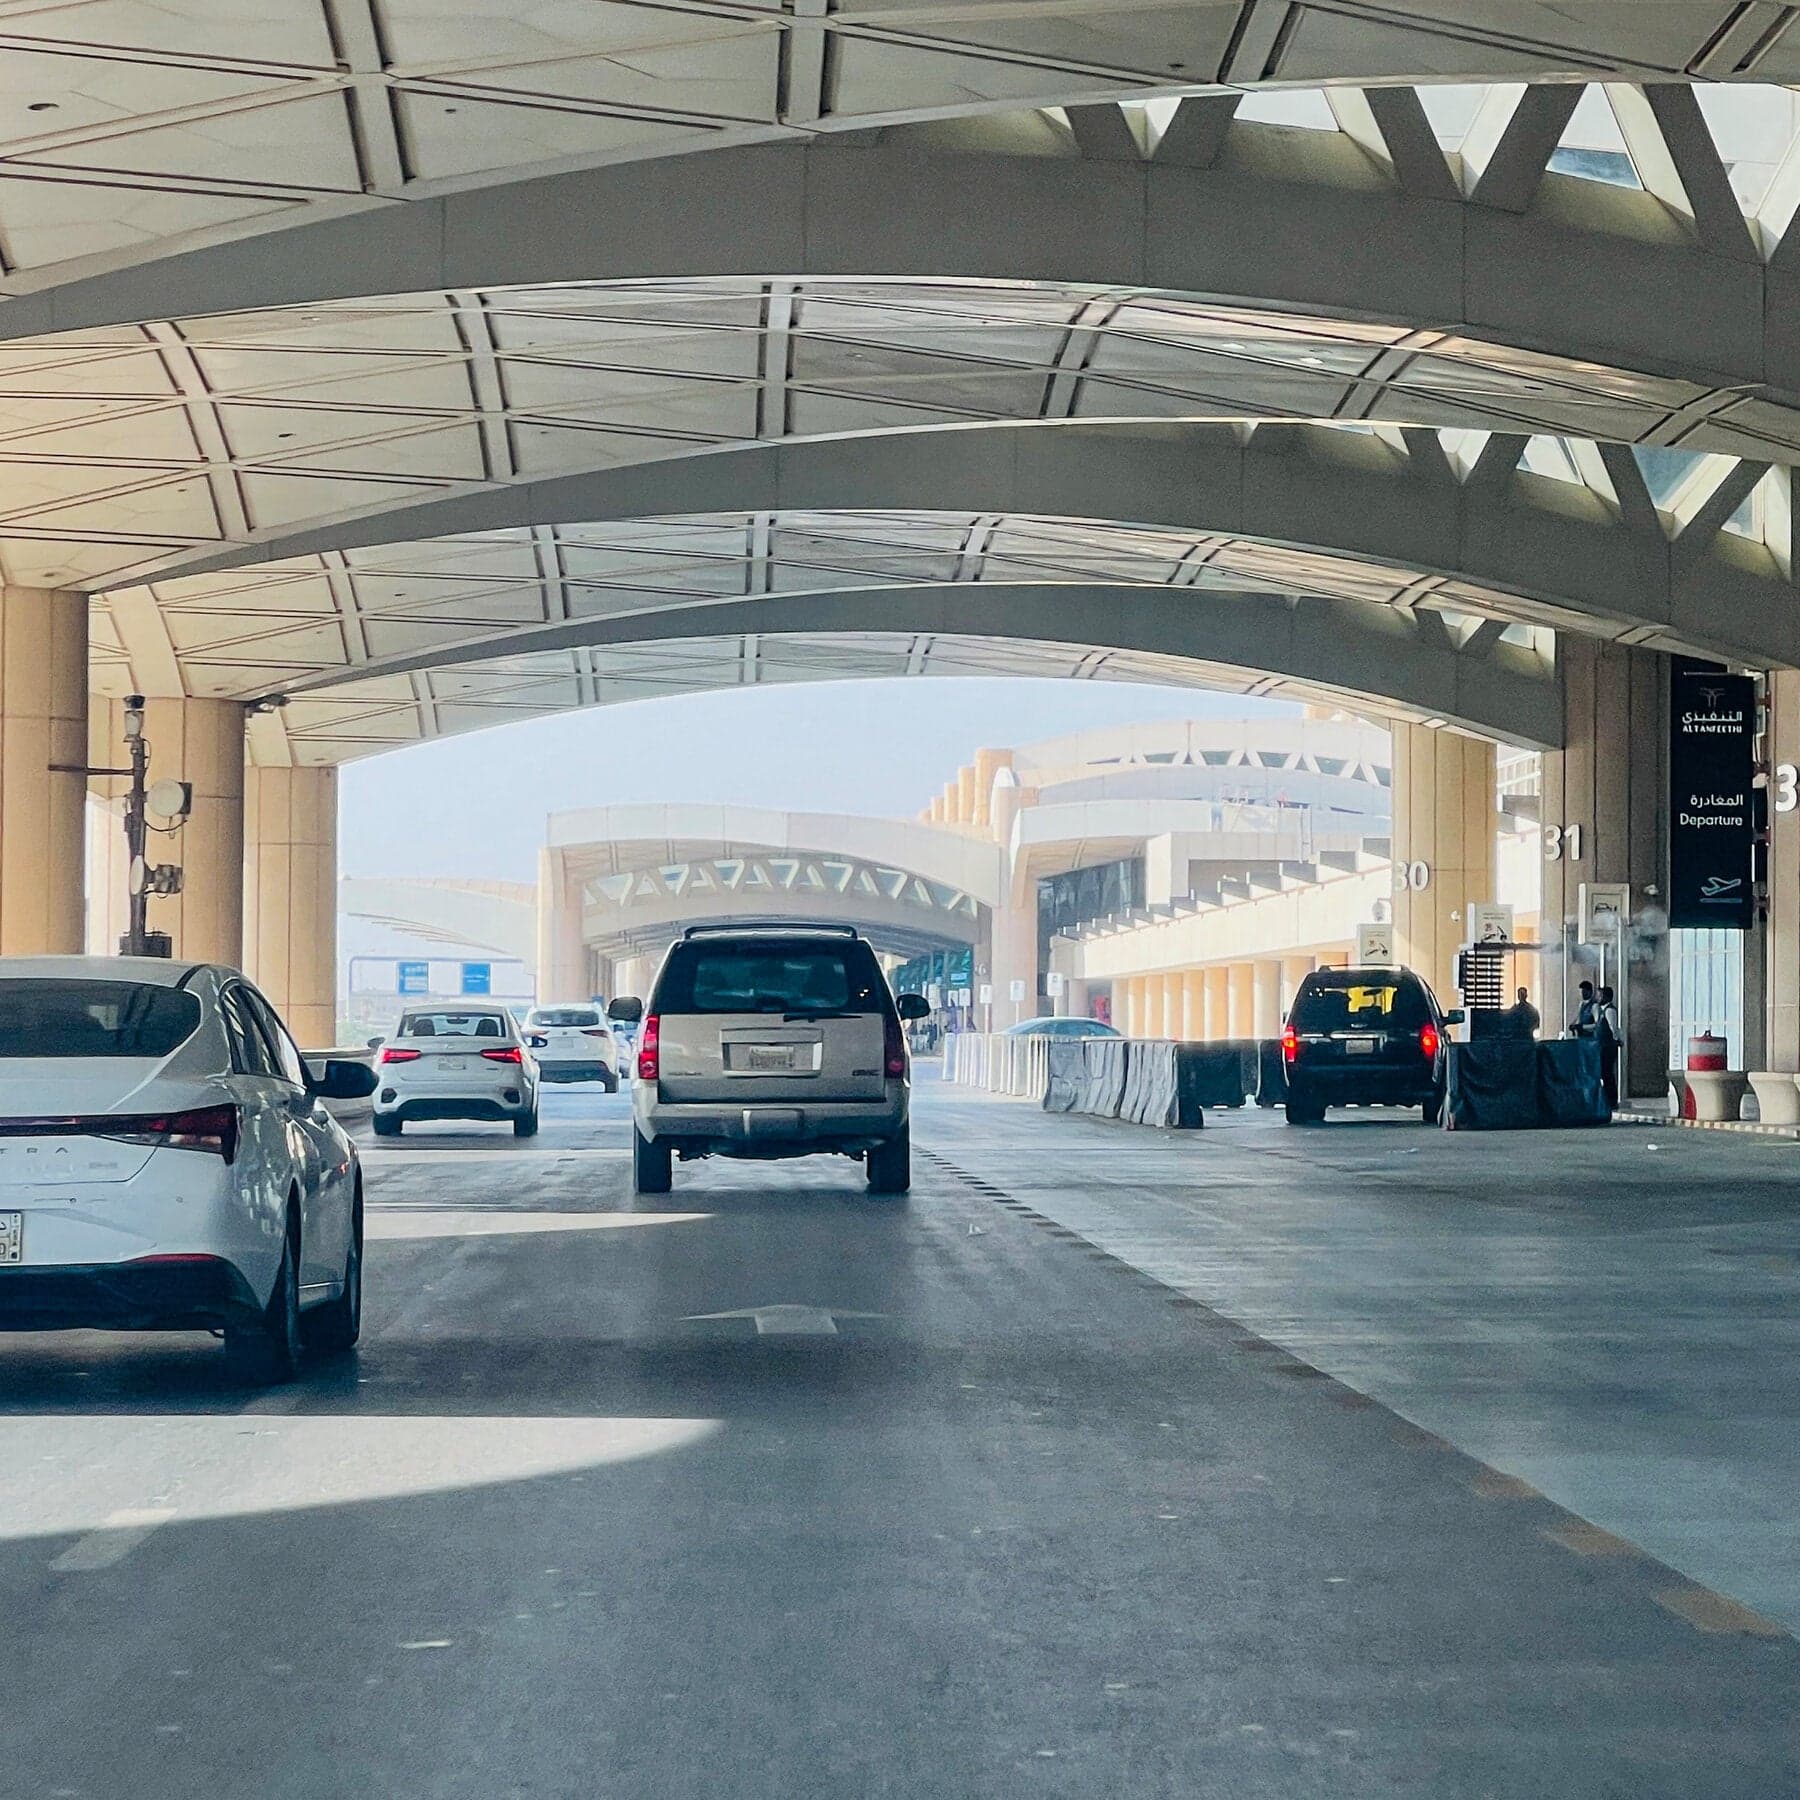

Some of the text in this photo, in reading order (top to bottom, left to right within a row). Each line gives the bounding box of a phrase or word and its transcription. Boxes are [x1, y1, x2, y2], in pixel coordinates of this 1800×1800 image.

[1690, 793, 1743, 809] المغادرة
[1680, 813, 1743, 829] Departure
[1544, 824, 1581, 860] 31
[1396, 860, 1429, 891] 30
